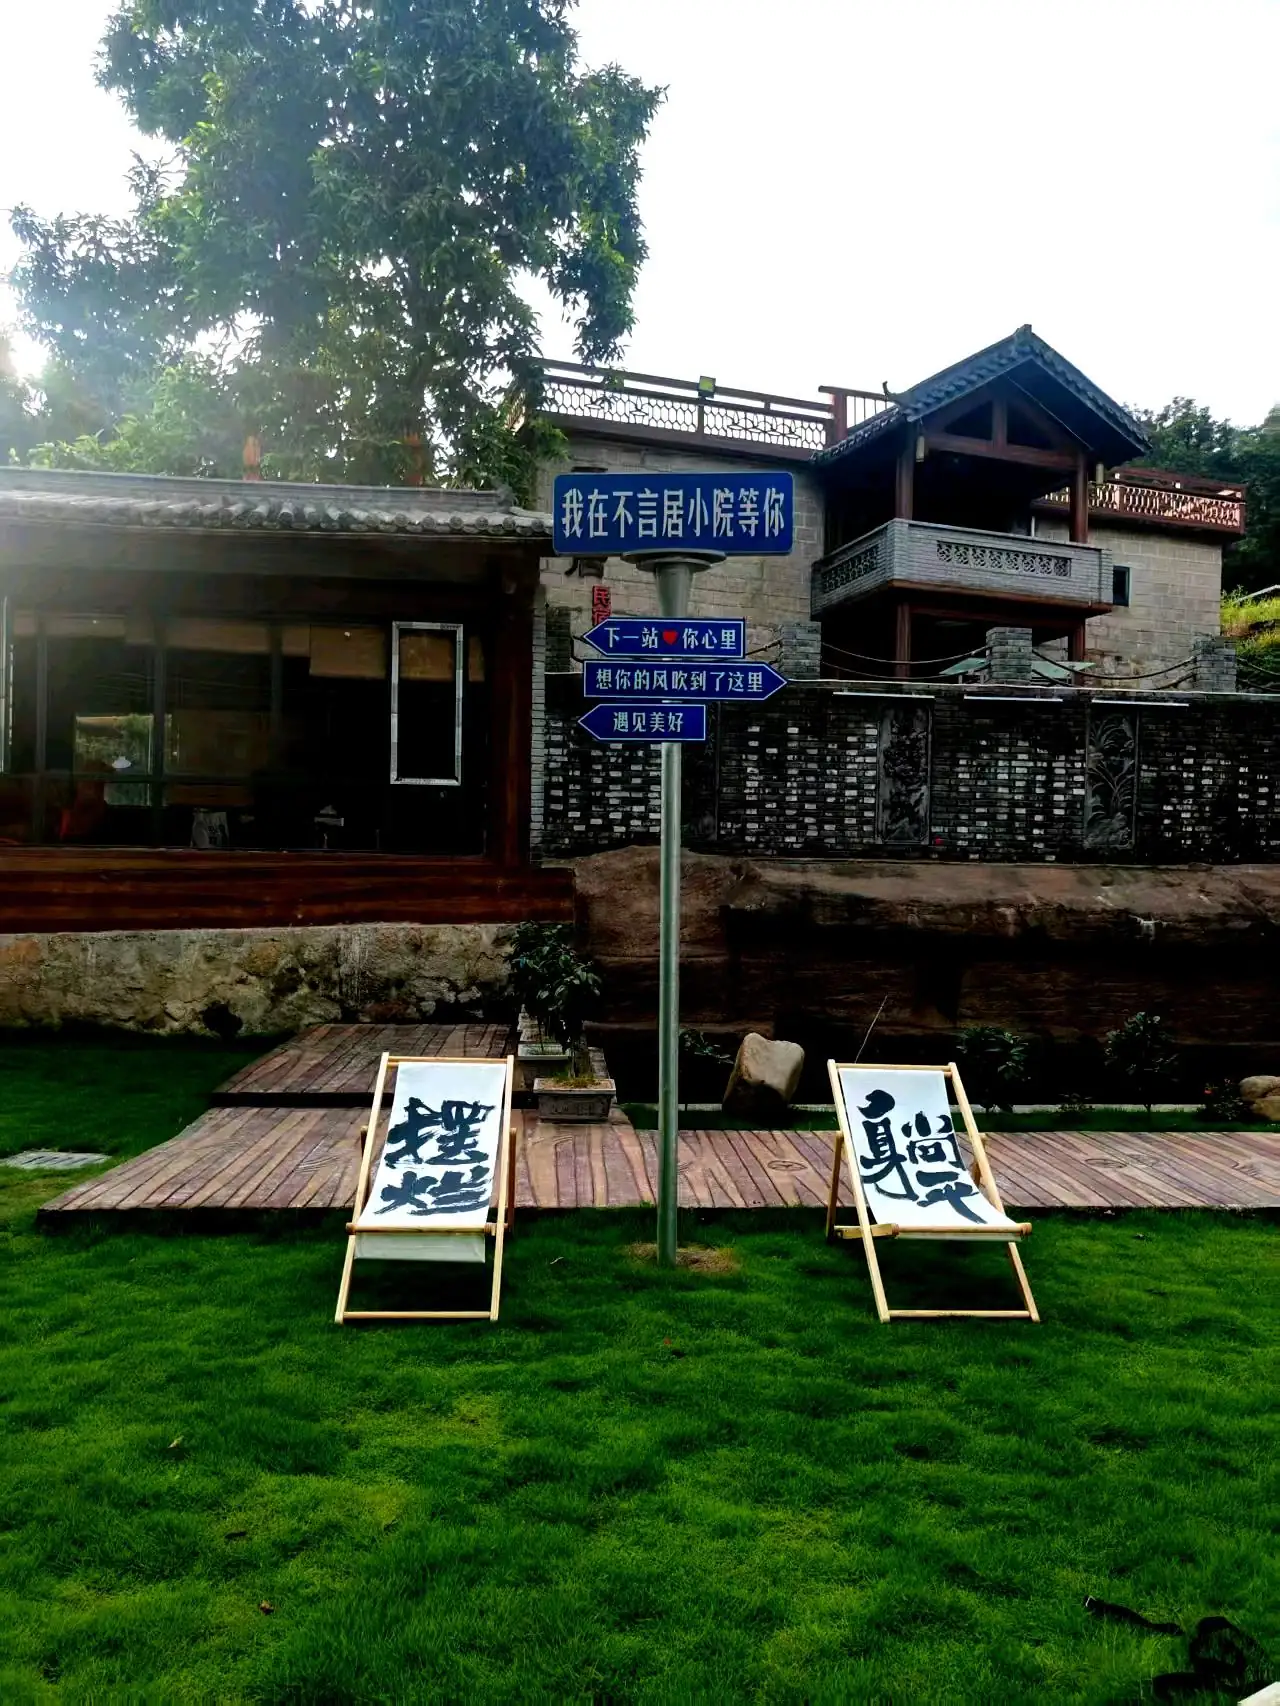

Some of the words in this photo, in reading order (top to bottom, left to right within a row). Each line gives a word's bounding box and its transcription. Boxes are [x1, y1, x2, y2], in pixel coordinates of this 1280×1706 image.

[562, 488, 785, 538] 我在不言居小院等你
[596, 669, 763, 693] 想你的风吹到了这里
[613, 711, 684, 733] 遇见美好
